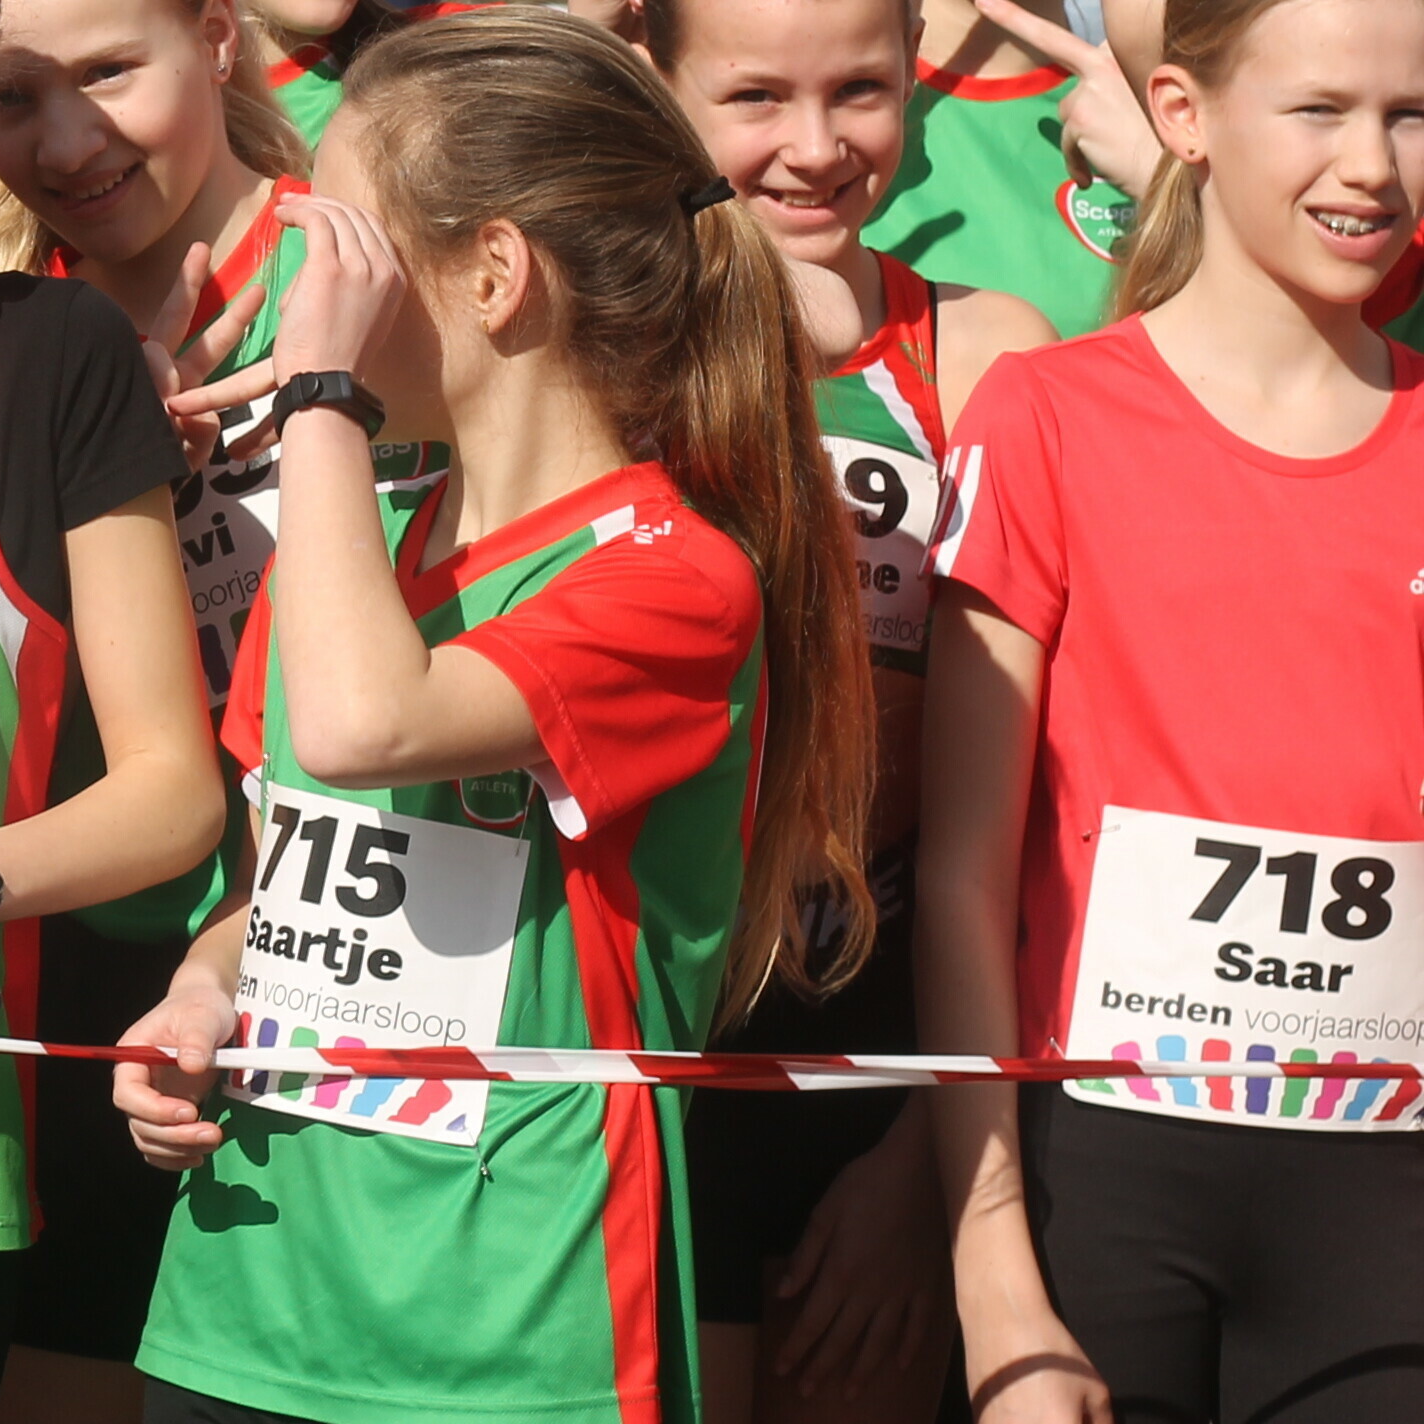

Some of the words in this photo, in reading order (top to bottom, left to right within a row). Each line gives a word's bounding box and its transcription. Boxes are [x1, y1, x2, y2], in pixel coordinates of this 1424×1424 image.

[258, 802, 411, 918] 715
[1189, 837, 1396, 941] 718
[246, 905, 403, 985] Saartje
[1214, 941, 1355, 994] Saar
[263, 978, 466, 1047] voorjaarsloop
[1100, 981, 1233, 1027] berden
